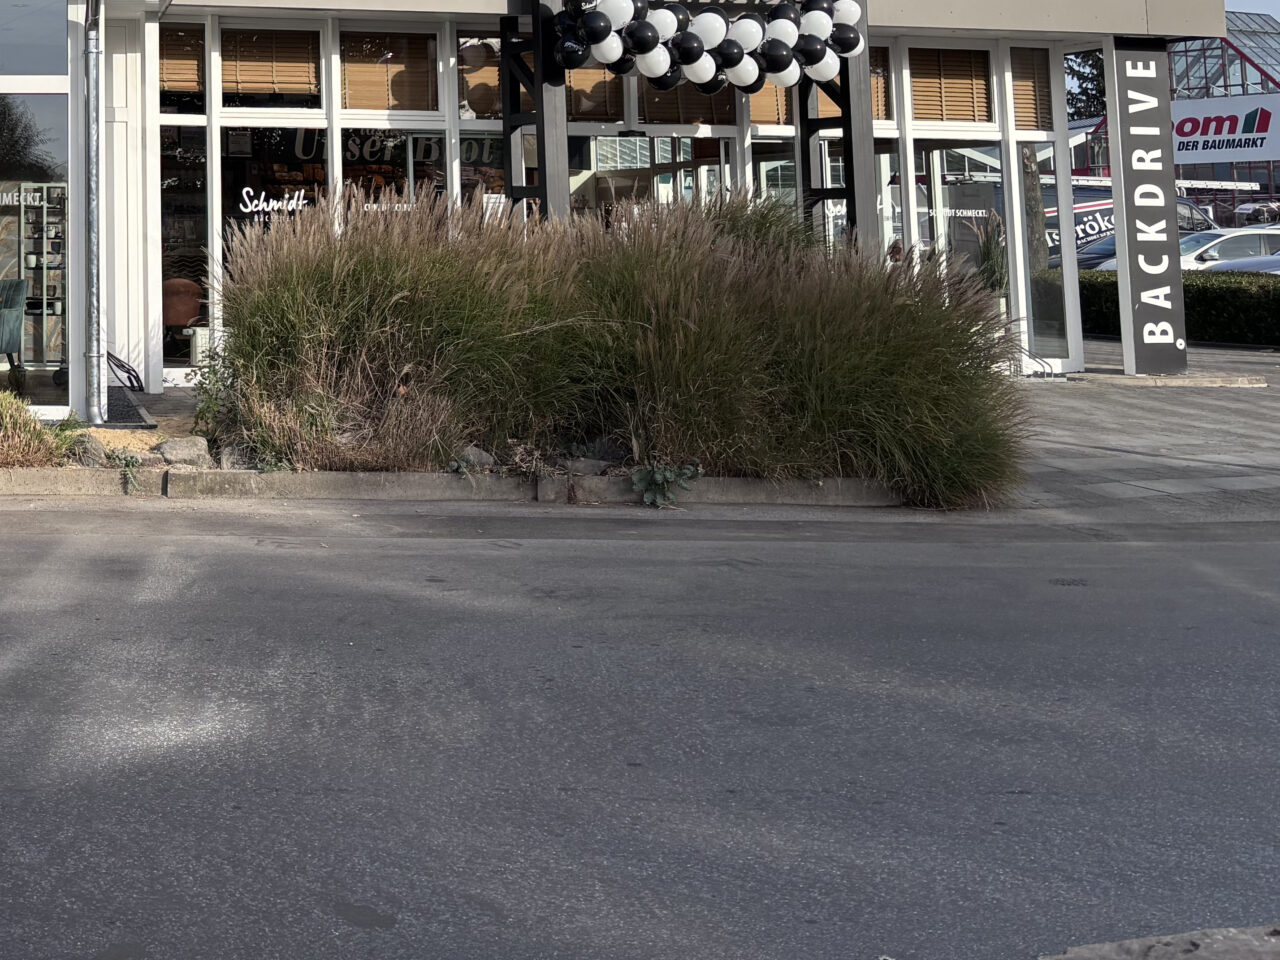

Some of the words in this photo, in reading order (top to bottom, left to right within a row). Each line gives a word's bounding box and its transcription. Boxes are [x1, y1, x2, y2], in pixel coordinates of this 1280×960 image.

[1177, 140, 1200, 152] DER
[1202, 136, 1267, 151] BAUMARKT
[239, 186, 309, 213] Schmidt
[1125, 60, 1175, 344] BACKDRIVE
[956, 209, 988, 217] SCHMECKT.
